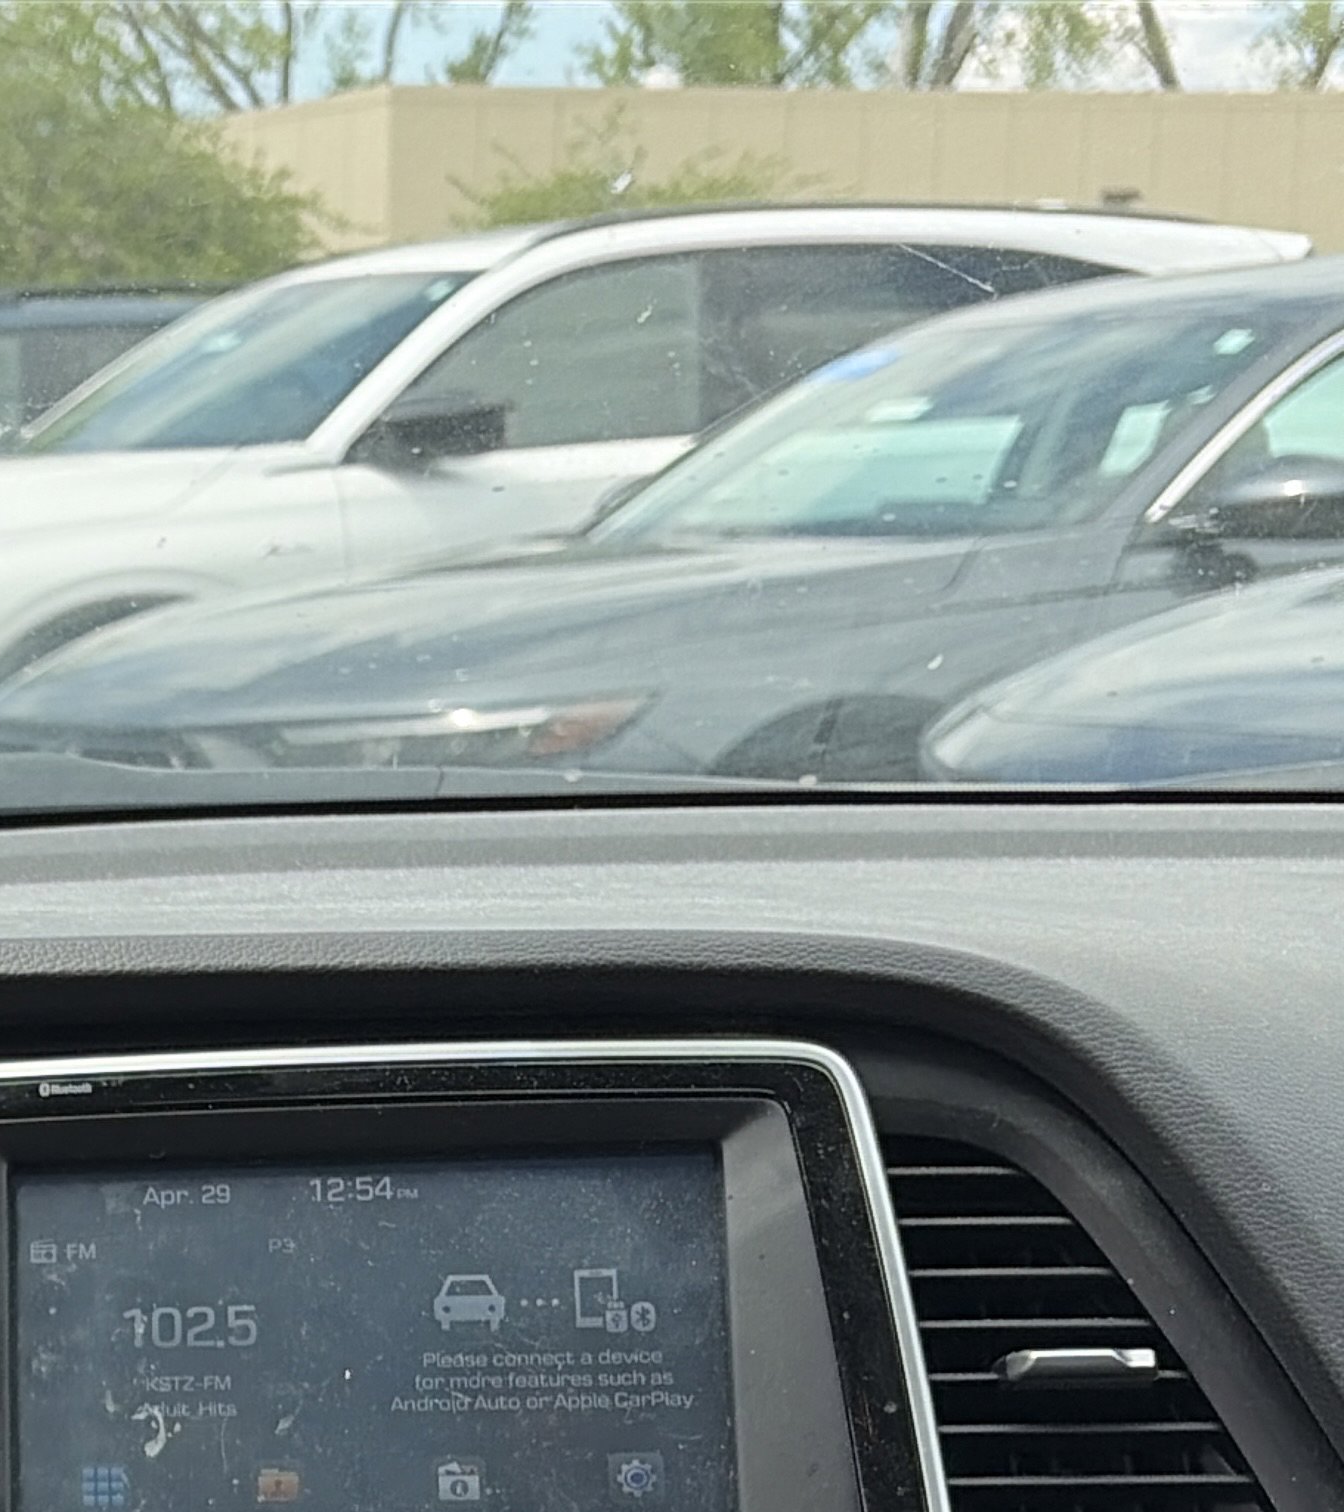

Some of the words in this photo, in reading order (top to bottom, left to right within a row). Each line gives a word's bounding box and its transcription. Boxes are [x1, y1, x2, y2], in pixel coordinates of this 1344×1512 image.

[143, 1185, 193, 1208] Apr.
[201, 1184, 231, 1204] 29
[310, 1177, 395, 1202] 12:54
[67, 1244, 96, 1260] FM
[123, 1305, 257, 1348] 102.5
[422, 1352, 487, 1367] Please
[493, 1352, 574, 1368] connect
[581, 1353, 592, 1365] a
[598, 1350, 663, 1365] device
[415, 1375, 444, 1390] for
[450, 1375, 503, 1388] more
[508, 1372, 593, 1388] features
[598, 1370, 646, 1386] such
[651, 1372, 673, 1385] as
[199, 1402, 237, 1417] Hits
[391, 1394, 471, 1412] Android
[474, 1395, 520, 1410] Auto
[527, 1395, 548, 1409] or
[554, 1394, 609, 1411] Apple
[615, 1392, 694, 1409] CarPlay
